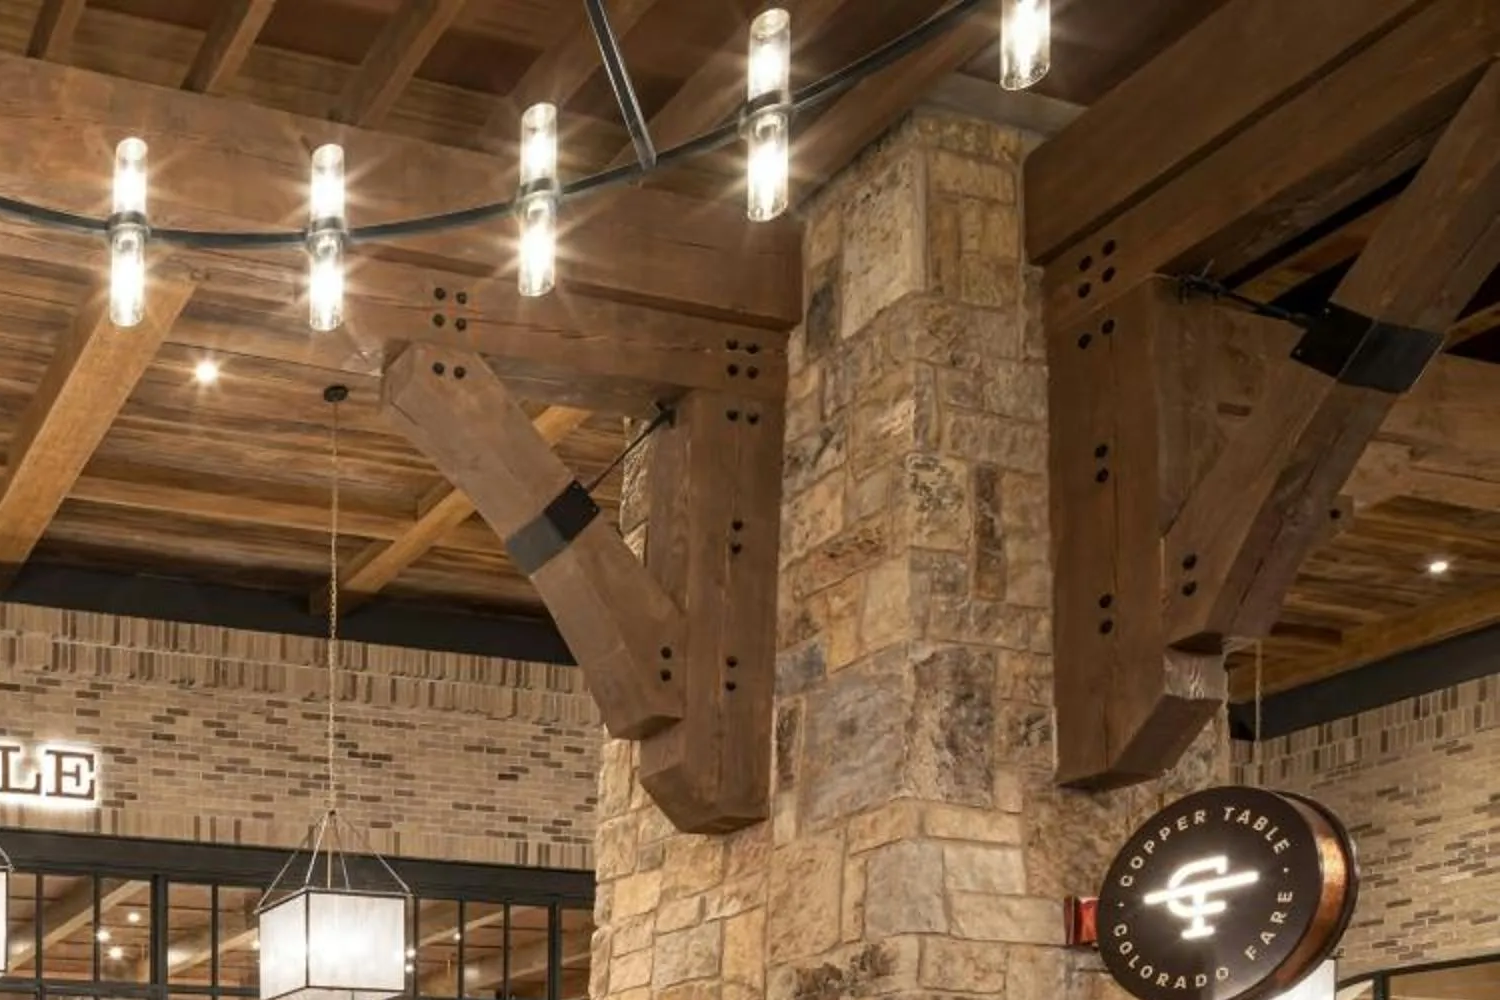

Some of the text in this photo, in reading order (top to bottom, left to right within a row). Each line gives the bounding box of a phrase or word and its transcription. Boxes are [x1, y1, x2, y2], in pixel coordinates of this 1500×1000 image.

[1119, 806, 1290, 888] COPPER TABLE
[1113, 890, 1294, 990] COLORADO FARE
